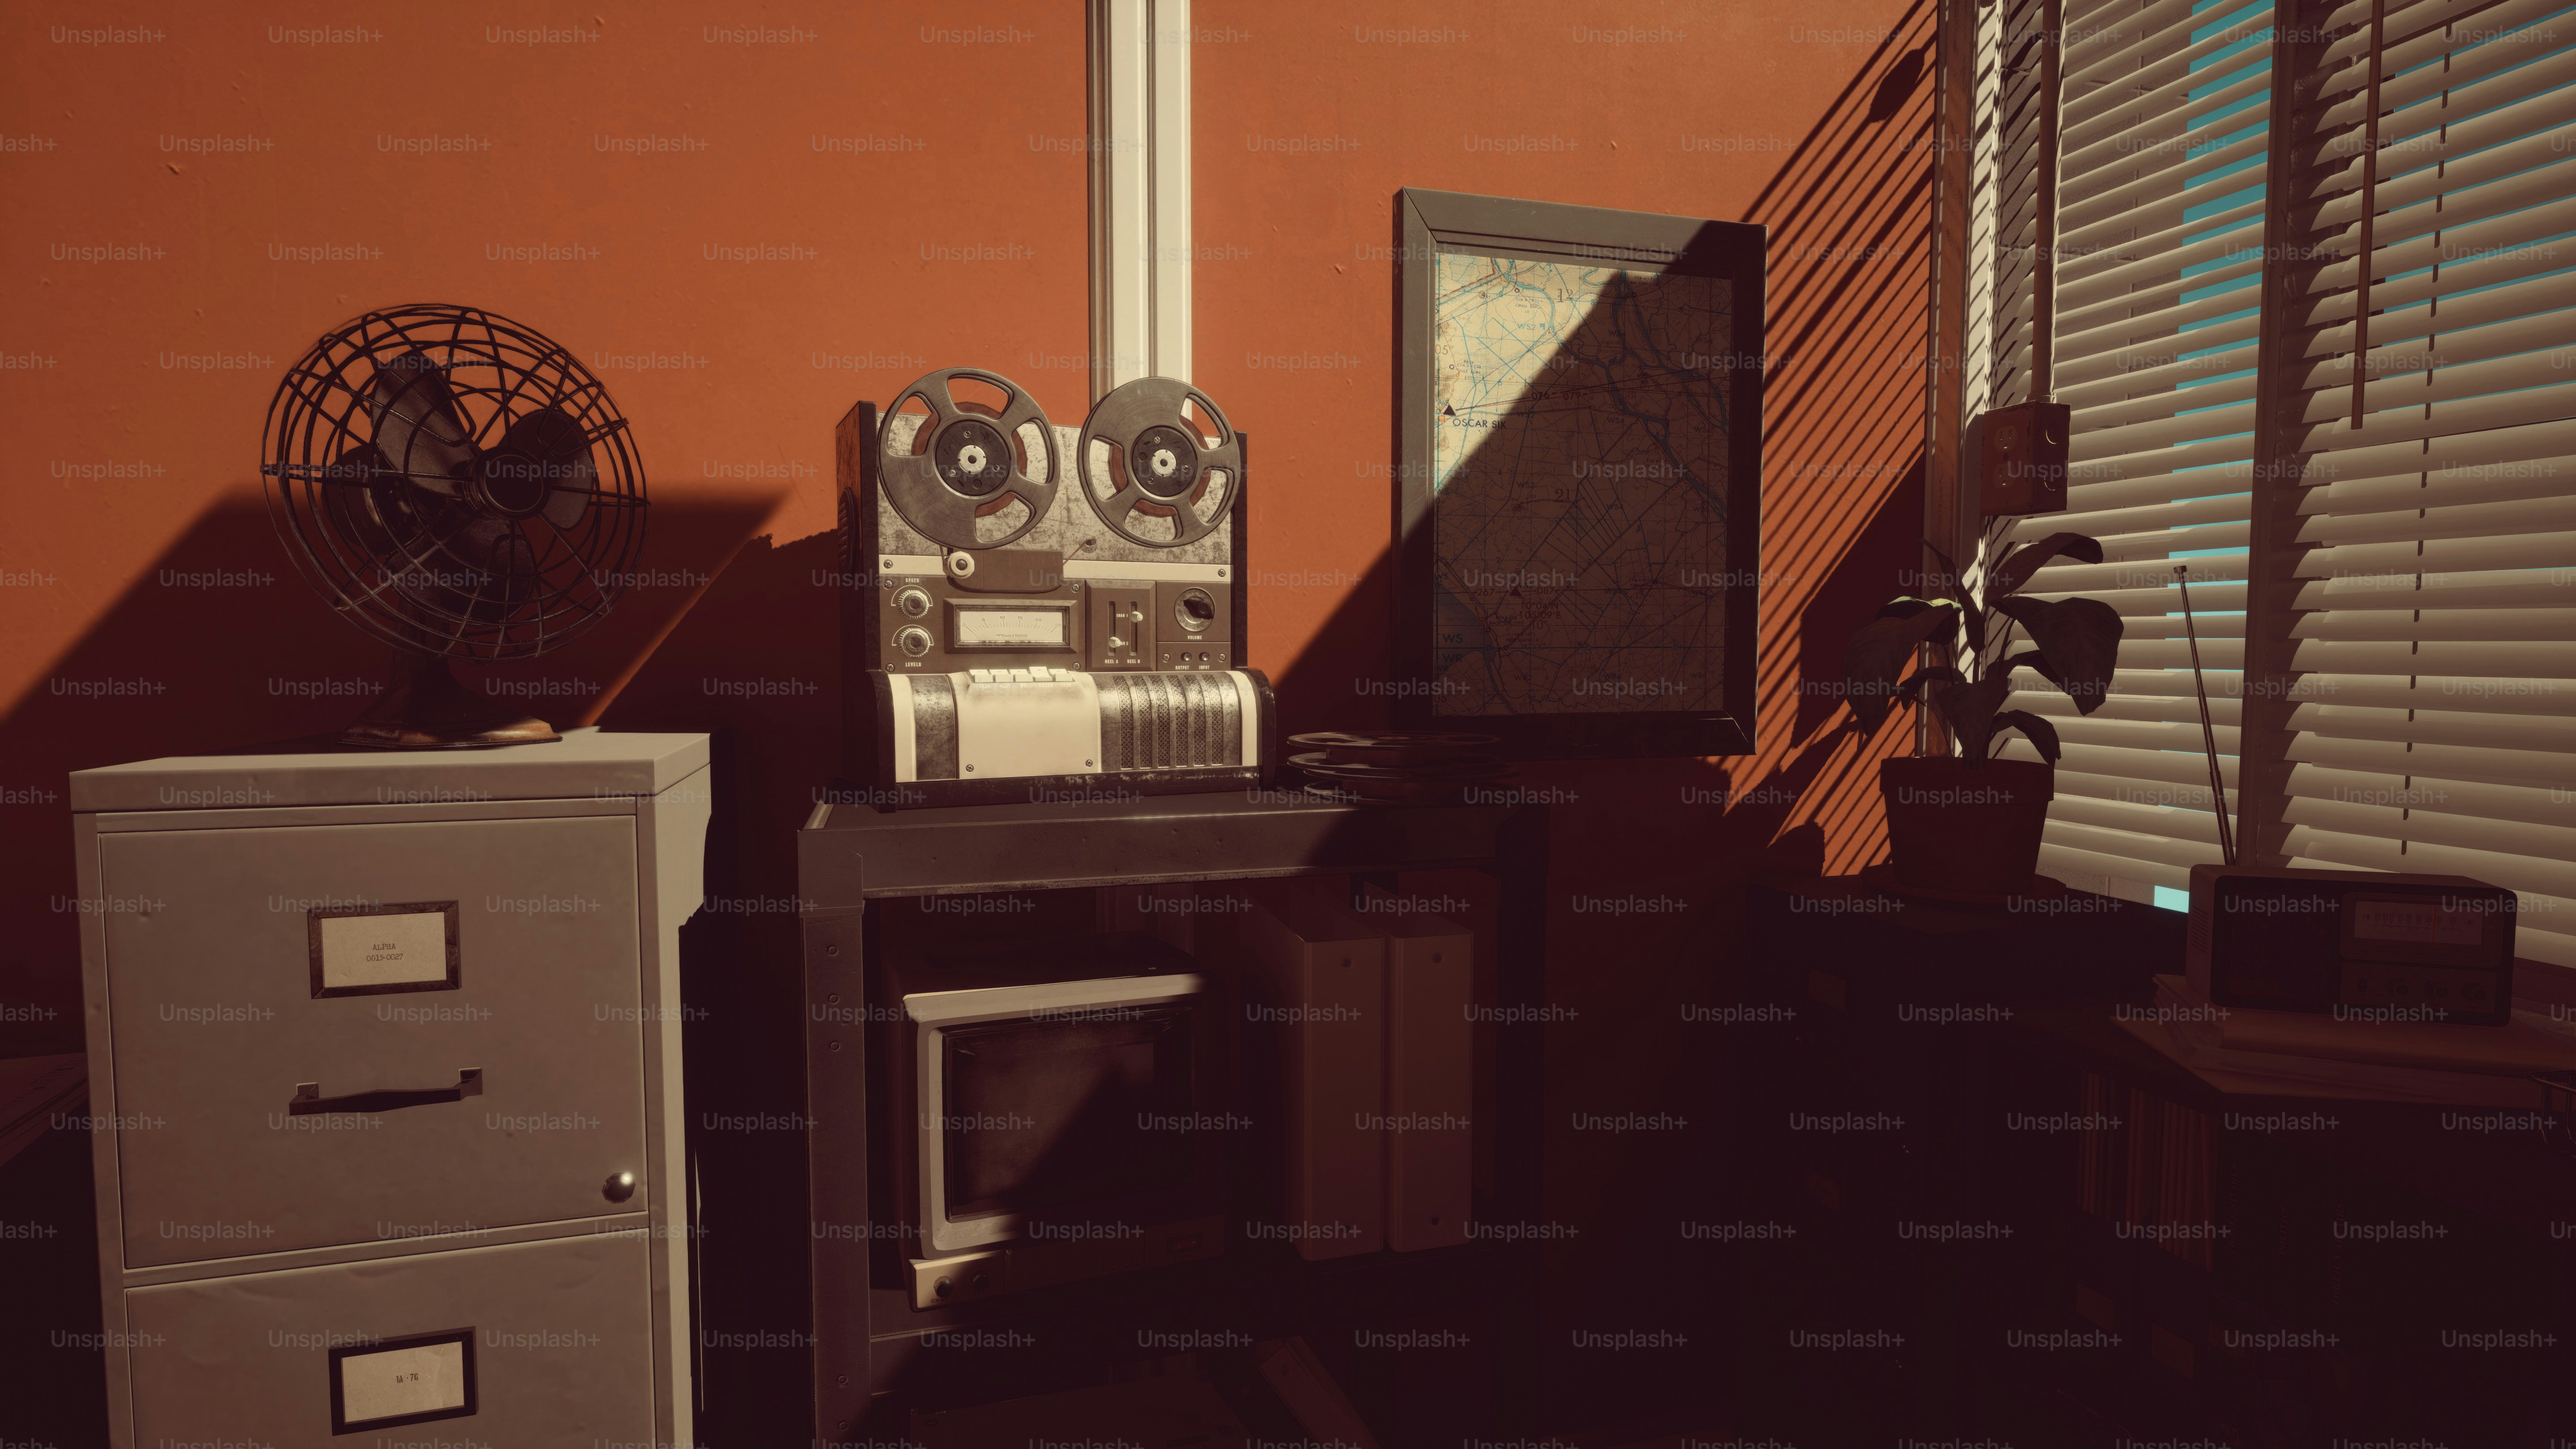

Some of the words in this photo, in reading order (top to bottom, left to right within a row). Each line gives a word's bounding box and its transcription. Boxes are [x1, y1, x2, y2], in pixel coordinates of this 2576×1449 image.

[1517, 322, 1536, 330] WS2
[1531, 391, 1550, 400] 076
[1563, 393, 1580, 401] 079
[1452, 418, 1488, 428] OSCAR
[1492, 420, 1507, 429] SIX
[1554, 487, 1571, 503] 21
[1476, 588, 1496, 596] 267
[1537, 587, 1555, 595] 087
[1442, 633, 1463, 644] WS
[1442, 653, 1462, 663] WR
[373, 943, 396, 951] ALPHA
[366, 953, 403, 962] 0015-0027
[396, 1375, 403, 1384] 1A
[409, 1373, 419, 1381] 7G
